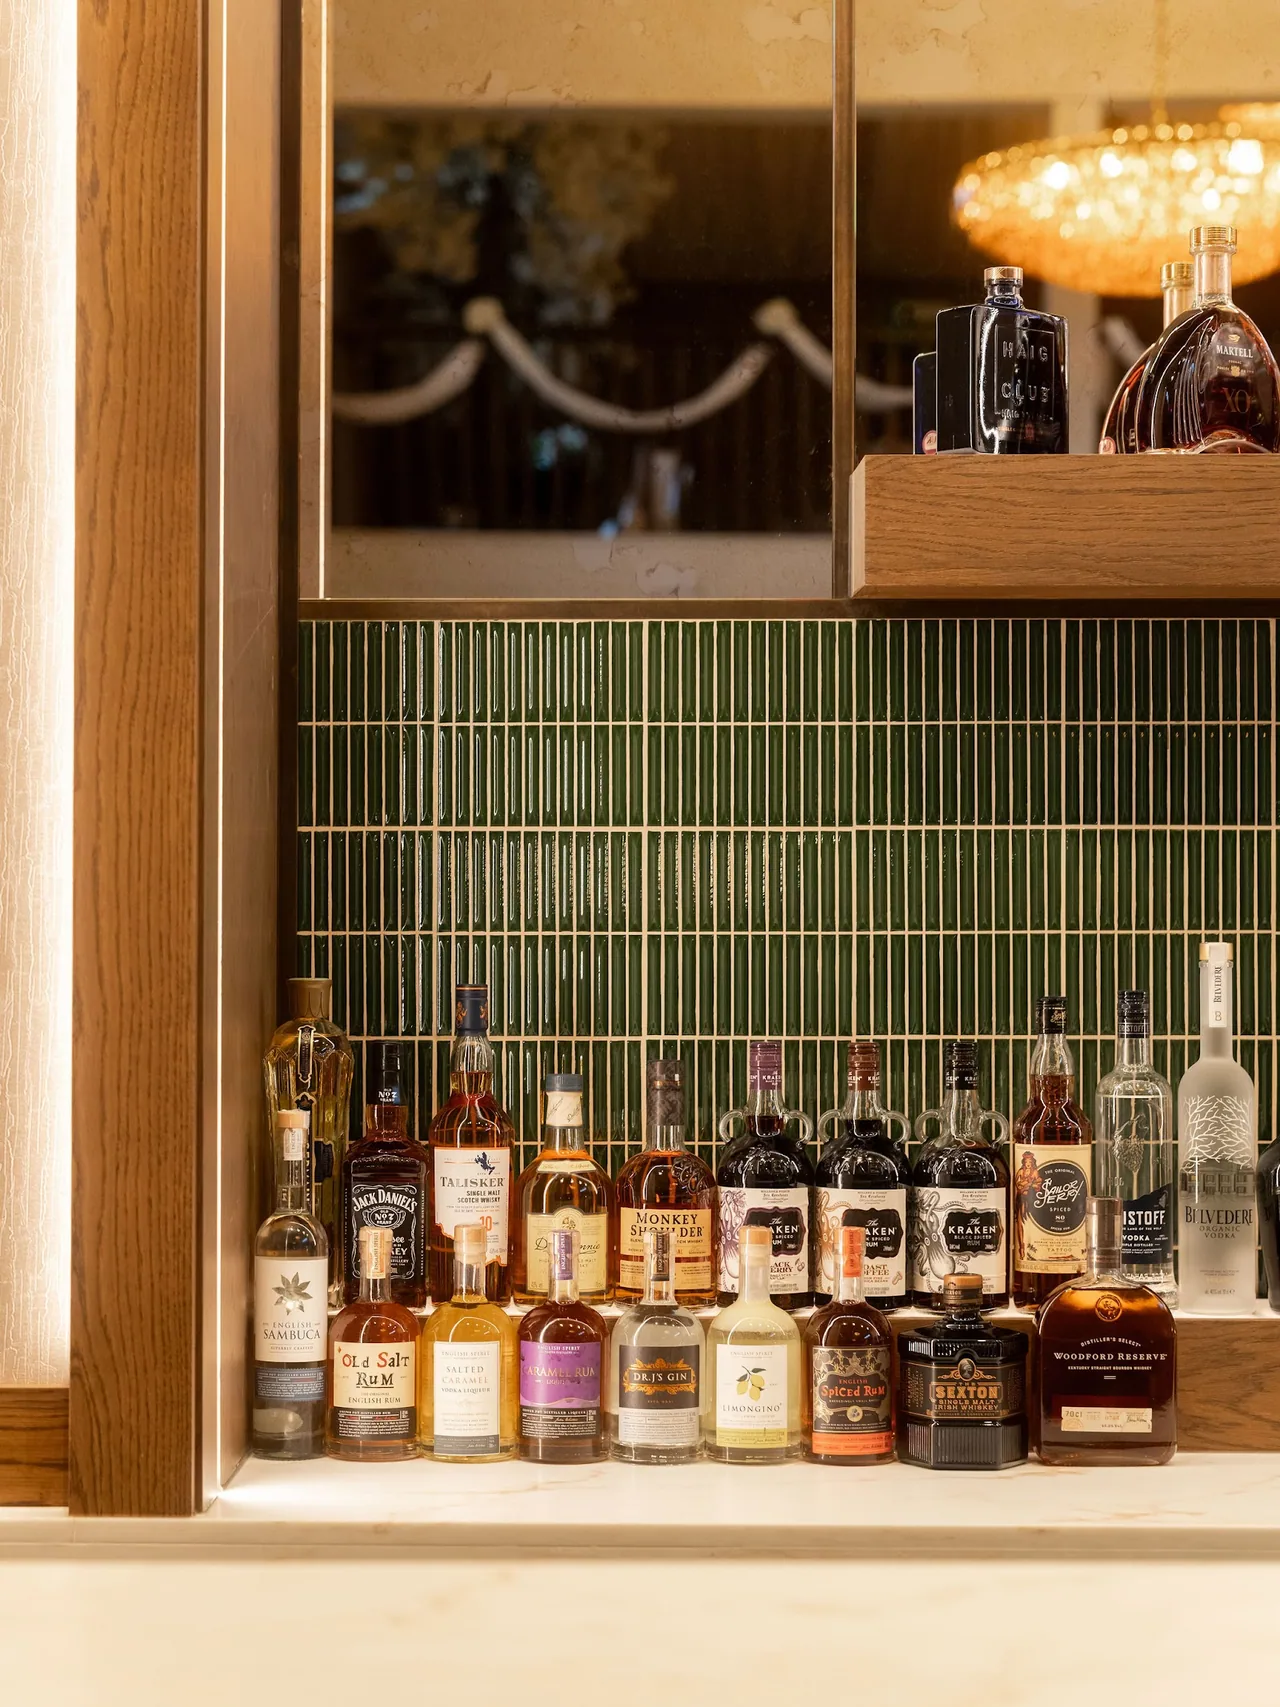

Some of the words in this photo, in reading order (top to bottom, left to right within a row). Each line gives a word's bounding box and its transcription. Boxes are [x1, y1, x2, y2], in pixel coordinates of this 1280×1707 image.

[1002, 340, 1048, 362] HAIG
[1216, 345, 1254, 358] MARTELL
[1222, 386, 1251, 413] XO
[1213, 966, 1222, 1003] BELVEDERE
[440, 1177, 504, 1188] TALISKER
[352, 1192, 378, 1212] JACK
[377, 1189, 418, 1213] DANIEL'S
[636, 1212, 698, 1225] MONKEY
[967, 1217, 980, 1225] The
[1123, 1210, 1166, 1225] ISTOFF
[1185, 1206, 1253, 1226] BELVEDERE
[769, 1225, 798, 1234] AKEN
[865, 1227, 896, 1236] AKEN
[948, 1225, 996, 1234] KRAKEN
[272, 1321, 312, 1329] ENGLISH
[263, 1329, 321, 1340] SAMBUCA
[1118, 1337, 1140, 1347] SELECT
[1053, 1352, 1114, 1361] WOODFORD
[1117, 1352, 1166, 1361] RESERVE
[575, 1366, 595, 1377] RUM
[667, 1373, 688, 1381] GIN
[441, 1376, 489, 1384] CARAMEL
[935, 1386, 998, 1399] SEXTON
[722, 1404, 780, 1413] LIMONGINO
[1065, 1410, 1083, 1418] 70cl
